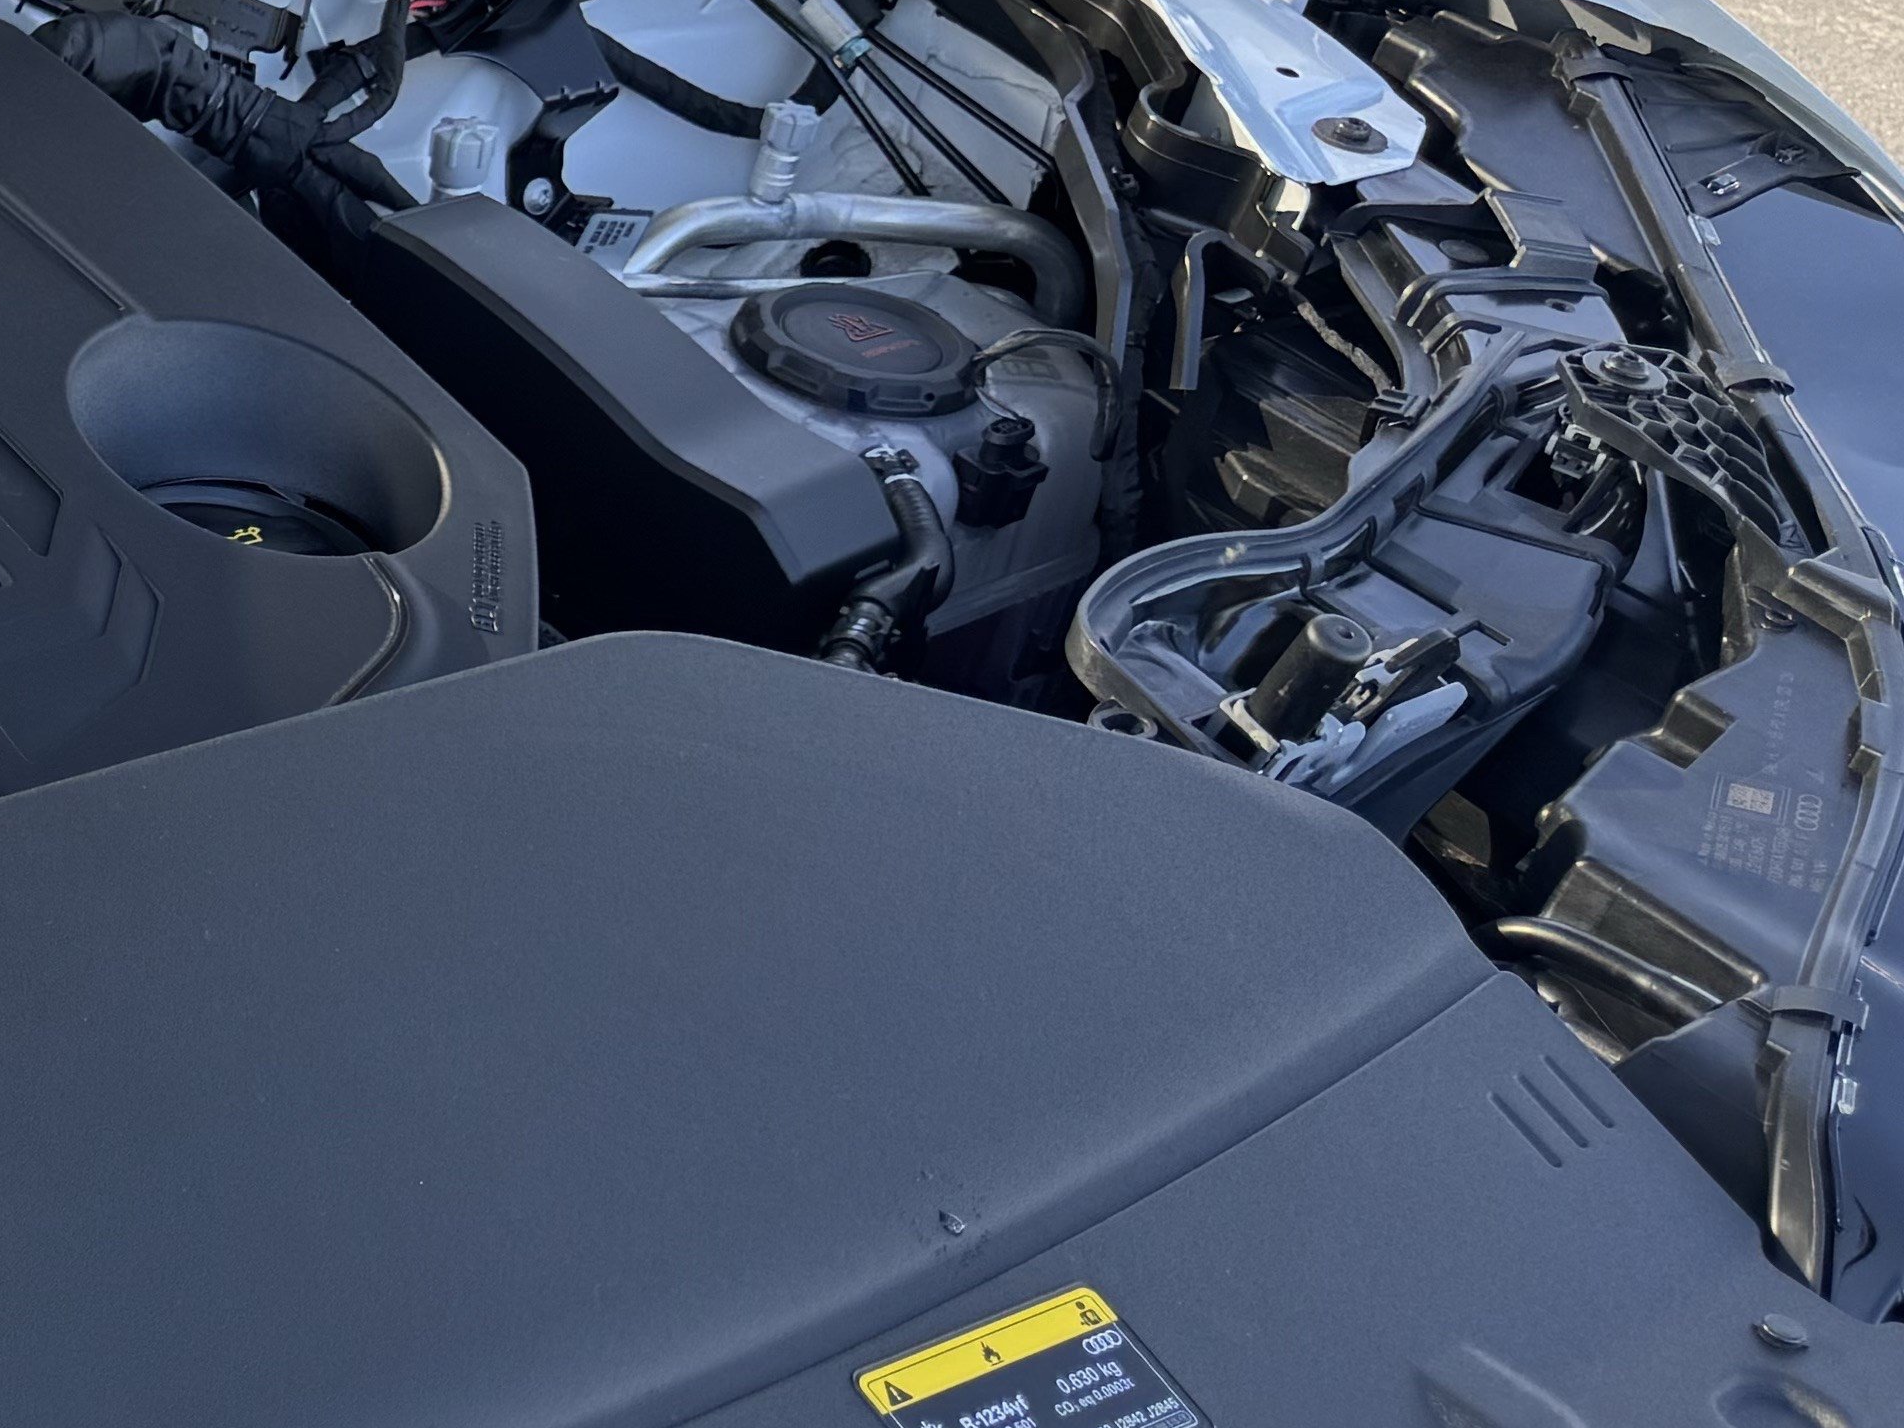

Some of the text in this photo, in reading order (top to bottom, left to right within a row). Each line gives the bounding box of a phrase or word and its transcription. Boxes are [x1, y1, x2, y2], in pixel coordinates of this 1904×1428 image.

[1055, 1358, 1123, 1393] 0.630 kg
[1077, 1394, 1096, 1408] eq
[1145, 1397, 1179, 1417] J2845
